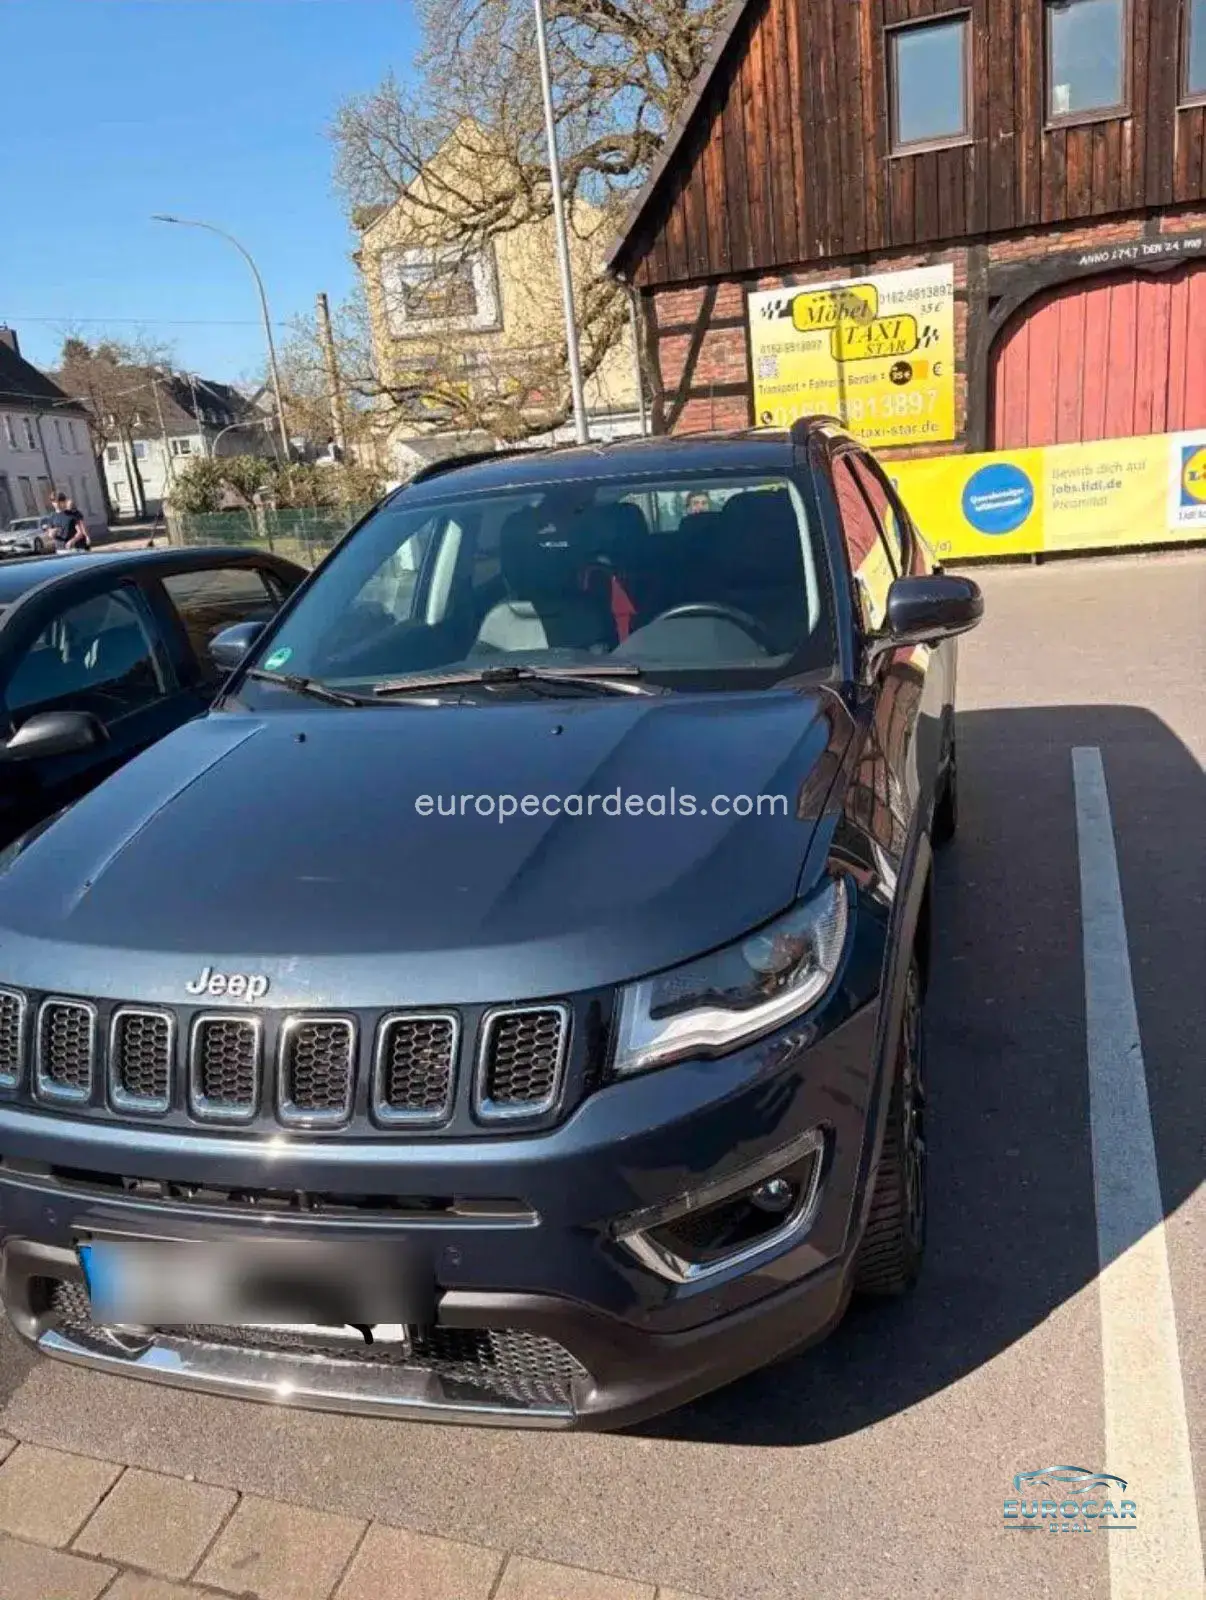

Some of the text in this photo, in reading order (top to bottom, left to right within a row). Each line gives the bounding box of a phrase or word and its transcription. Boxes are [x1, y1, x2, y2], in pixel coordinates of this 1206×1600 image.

[1079, 252, 1109, 266] ANNO
[1142, 243, 1162, 255] DEN
[806, 299, 869, 323] Möbel
[845, 320, 903, 345] TAXI
[867, 339, 906, 355] STAR
[758, 383, 800, 397] Transport
[1052, 478, 1122, 497] jobs.lidl.de
[185, 967, 270, 1004] Jeep
